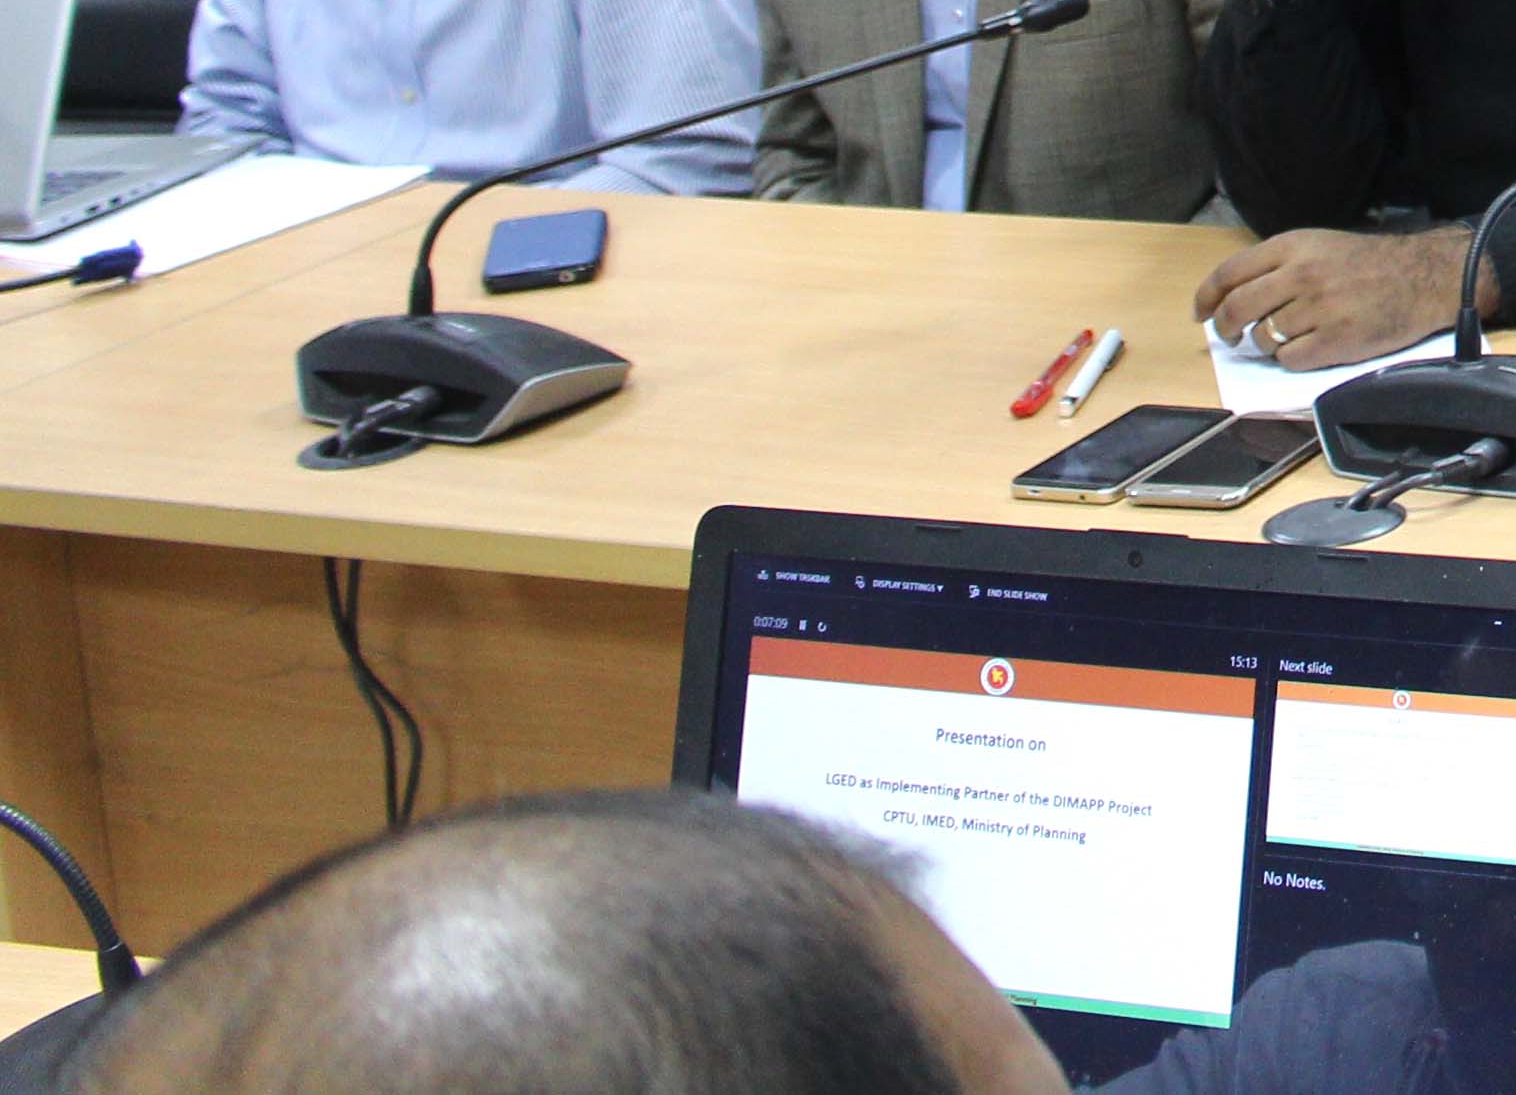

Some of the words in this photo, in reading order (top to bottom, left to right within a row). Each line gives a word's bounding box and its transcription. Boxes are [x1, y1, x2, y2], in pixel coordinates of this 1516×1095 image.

[775, 571, 797, 581] SHOW
[798, 573, 831, 584] TASKBAR
[872, 579, 901, 590] DISPLAY
[902, 581, 935, 592] SETTINGS
[987, 588, 1001, 598] END
[1003, 589, 1023, 600] SLIDE
[1024, 591, 1048, 601] SHOW
[753, 616, 788, 630] 0:07:09
[1230, 655, 1258, 669] 15:13
[1279, 659, 1305, 673] Next
[1306, 660, 1333, 675] slide
[935, 727, 1024, 751] Presentation
[1028, 738, 1047, 752] on
[826, 772, 857, 788] LGED
[860, 778, 873, 789] as
[876, 777, 961, 801] Implementing
[964, 786, 1010, 803] Partner
[1013, 791, 1027, 805] of
[1029, 793, 1050, 807] the
[1053, 795, 1105, 811] DIMAPP
[1108, 799, 1153, 817] Project
[883, 810, 919, 827] CPTU,
[922, 813, 958, 830] IMED,
[962, 818, 1014, 838] Ministry
[1017, 823, 1030, 837] of
[1033, 825, 1087, 845] Planning
[1263, 870, 1283, 887] No
[1285, 872, 1327, 891] Notes.
